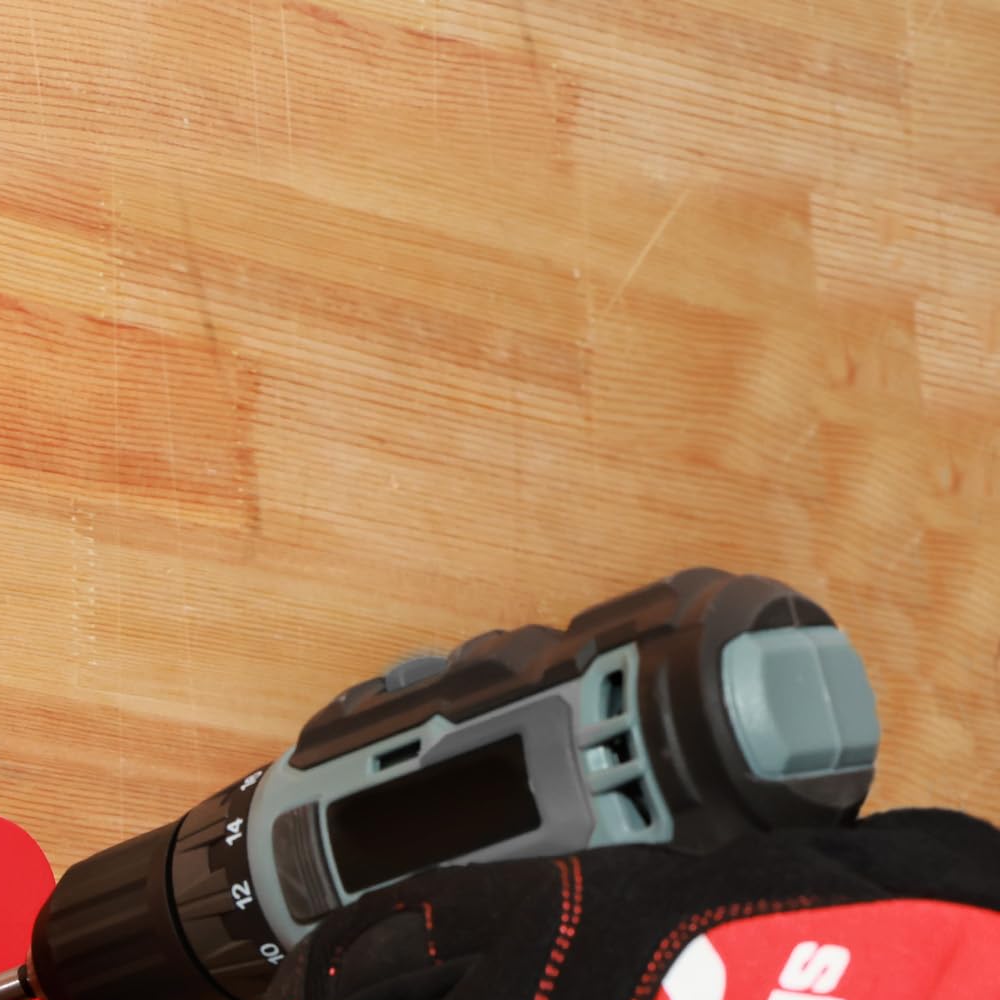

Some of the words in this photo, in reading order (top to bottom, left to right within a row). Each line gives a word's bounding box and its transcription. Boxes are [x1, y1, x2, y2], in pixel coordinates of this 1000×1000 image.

[225, 817, 244, 846] 14
[231, 880, 253, 910] 12
[260, 943, 285, 965] 10
